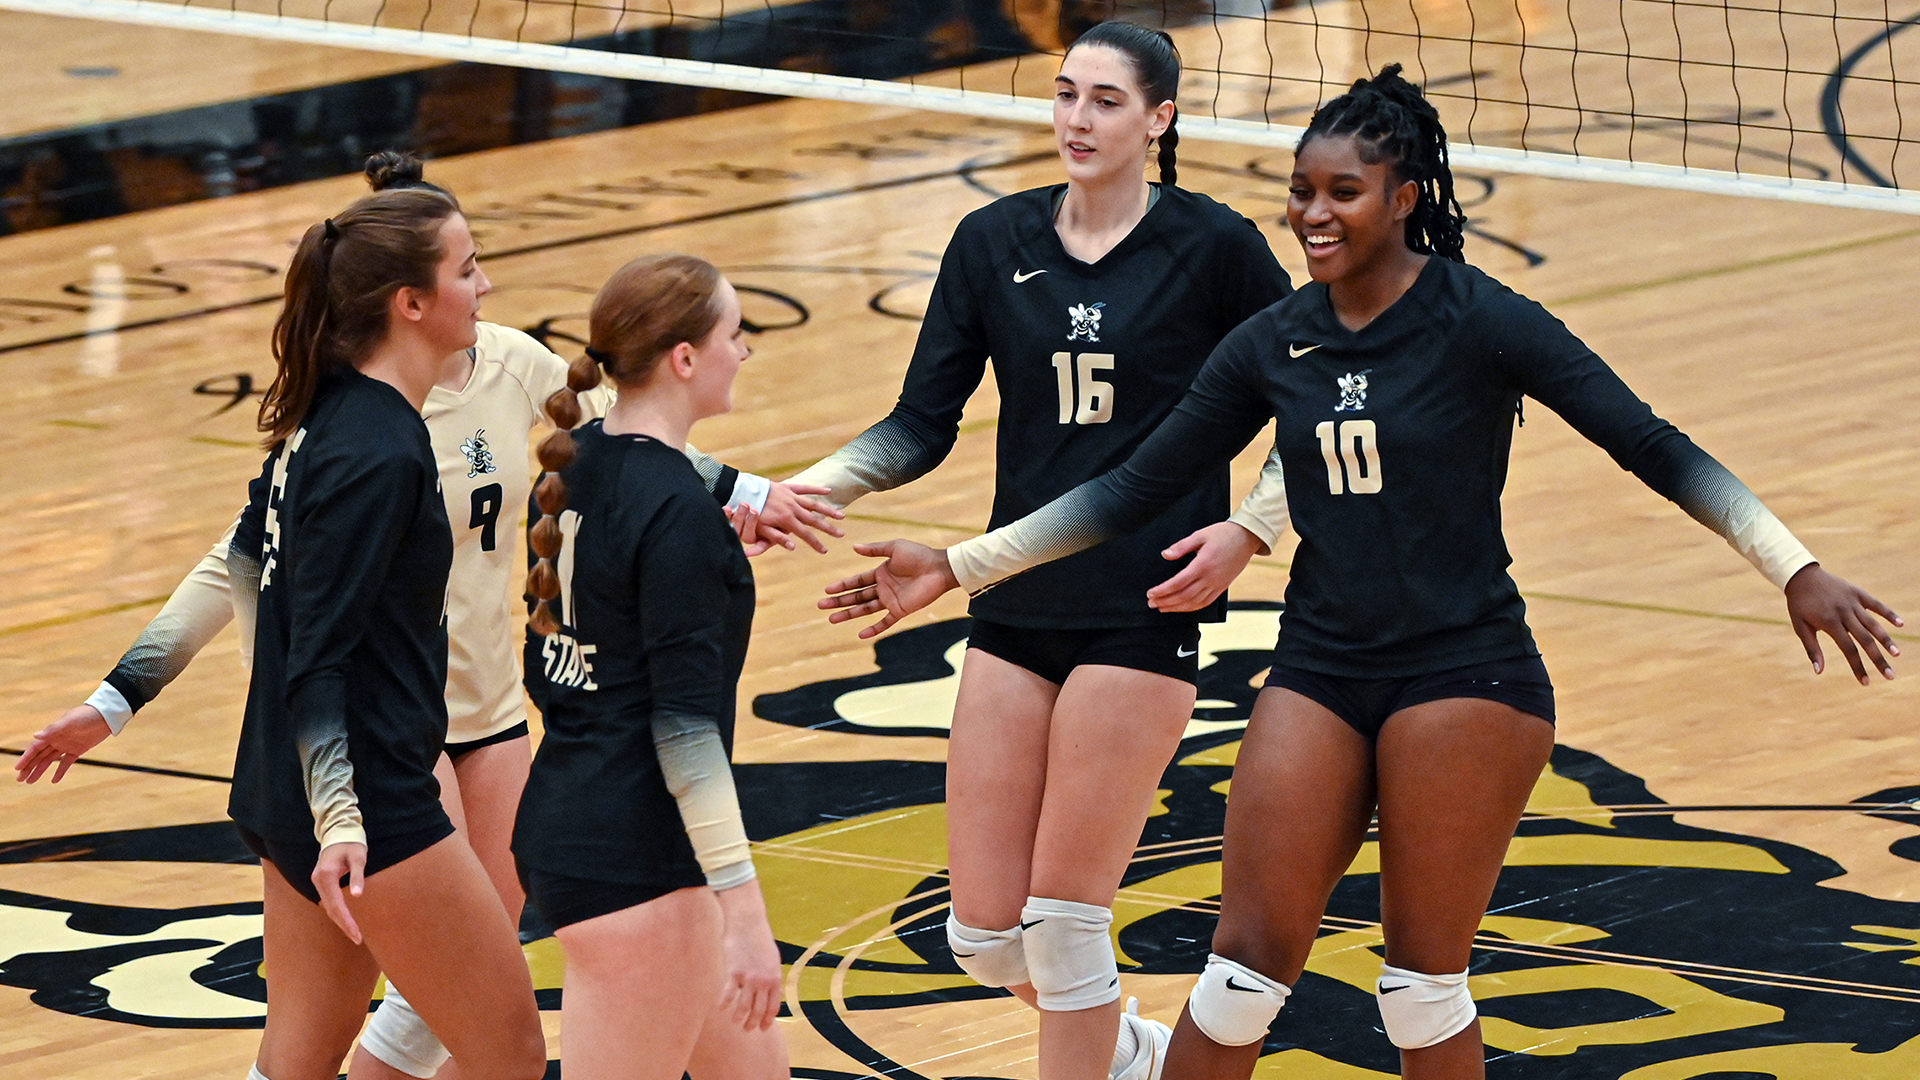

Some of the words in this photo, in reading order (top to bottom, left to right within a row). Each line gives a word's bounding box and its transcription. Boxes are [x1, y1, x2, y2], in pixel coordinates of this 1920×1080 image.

[1052, 352, 1115, 425] 16
[1315, 420, 1383, 495] 10
[469, 482, 504, 552] 9
